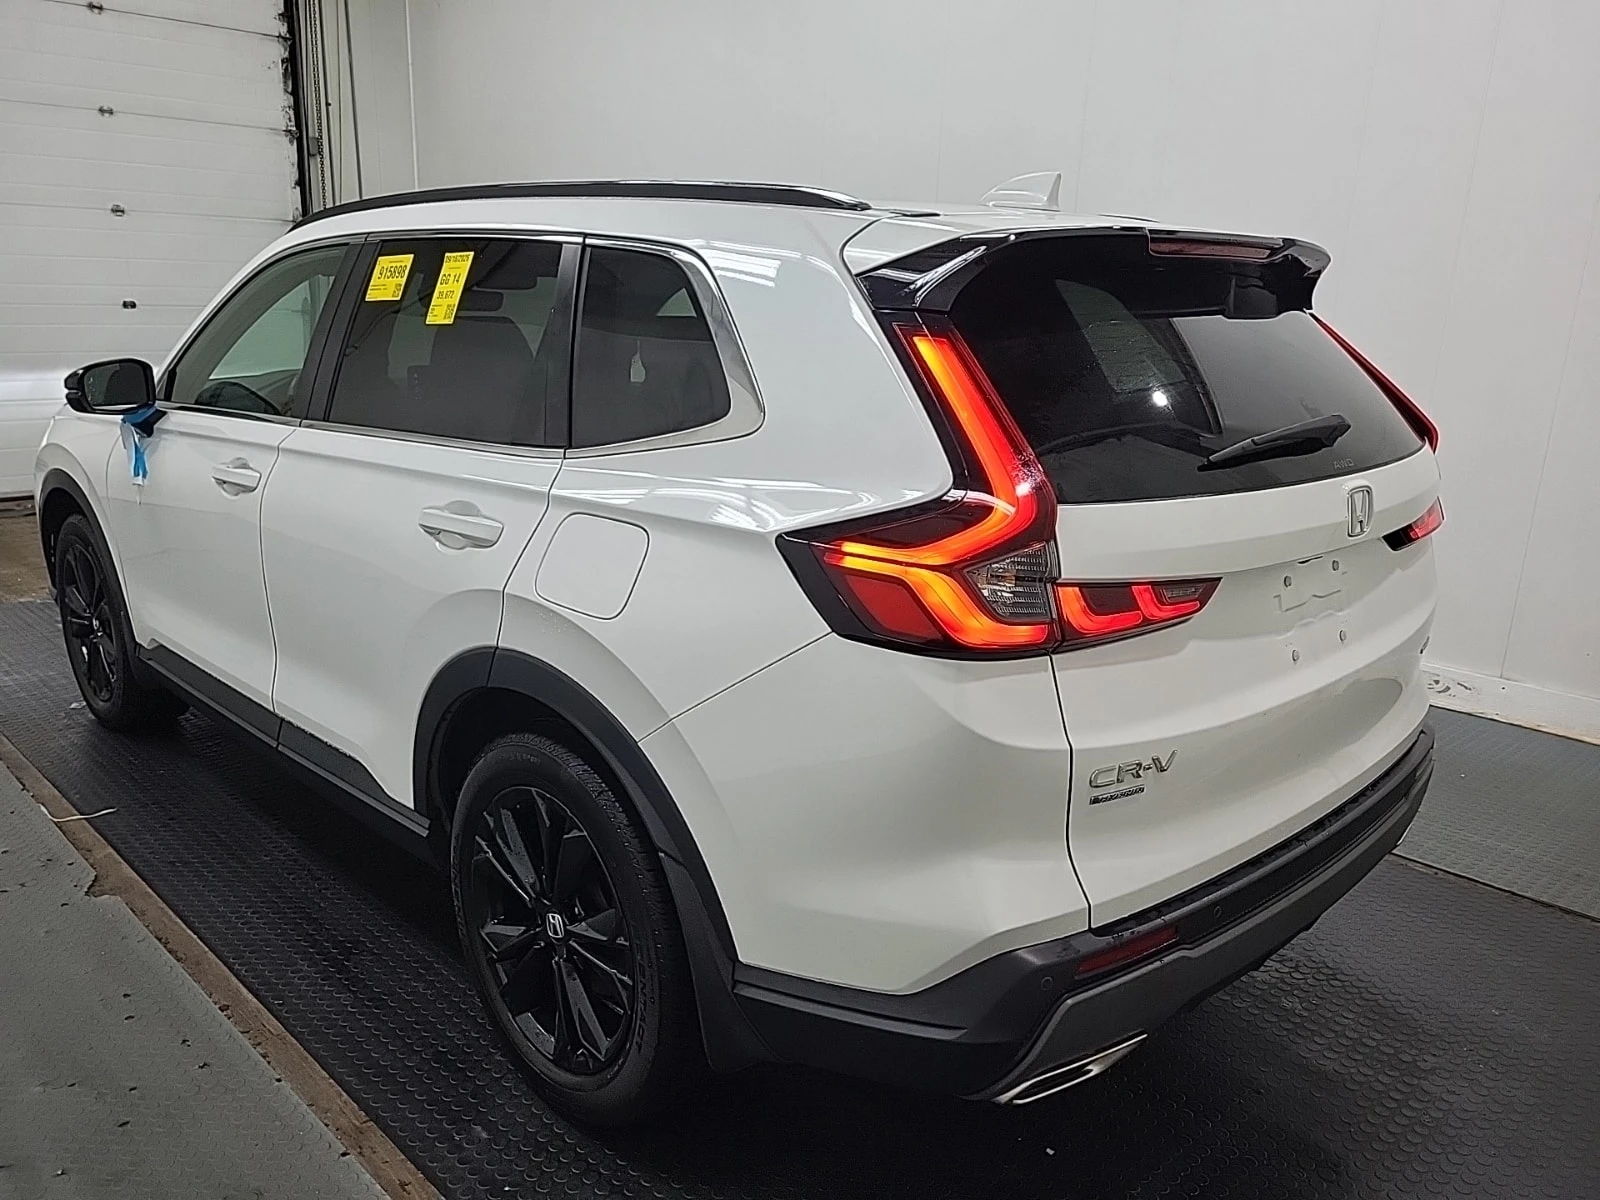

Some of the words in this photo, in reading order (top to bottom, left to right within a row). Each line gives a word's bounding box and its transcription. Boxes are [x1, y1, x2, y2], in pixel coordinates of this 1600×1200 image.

[377, 264, 408, 280] 915898
[452, 272, 462, 285] 14
[1333, 459, 1354, 470] AWD
[1089, 749, 1178, 788] CR-V
